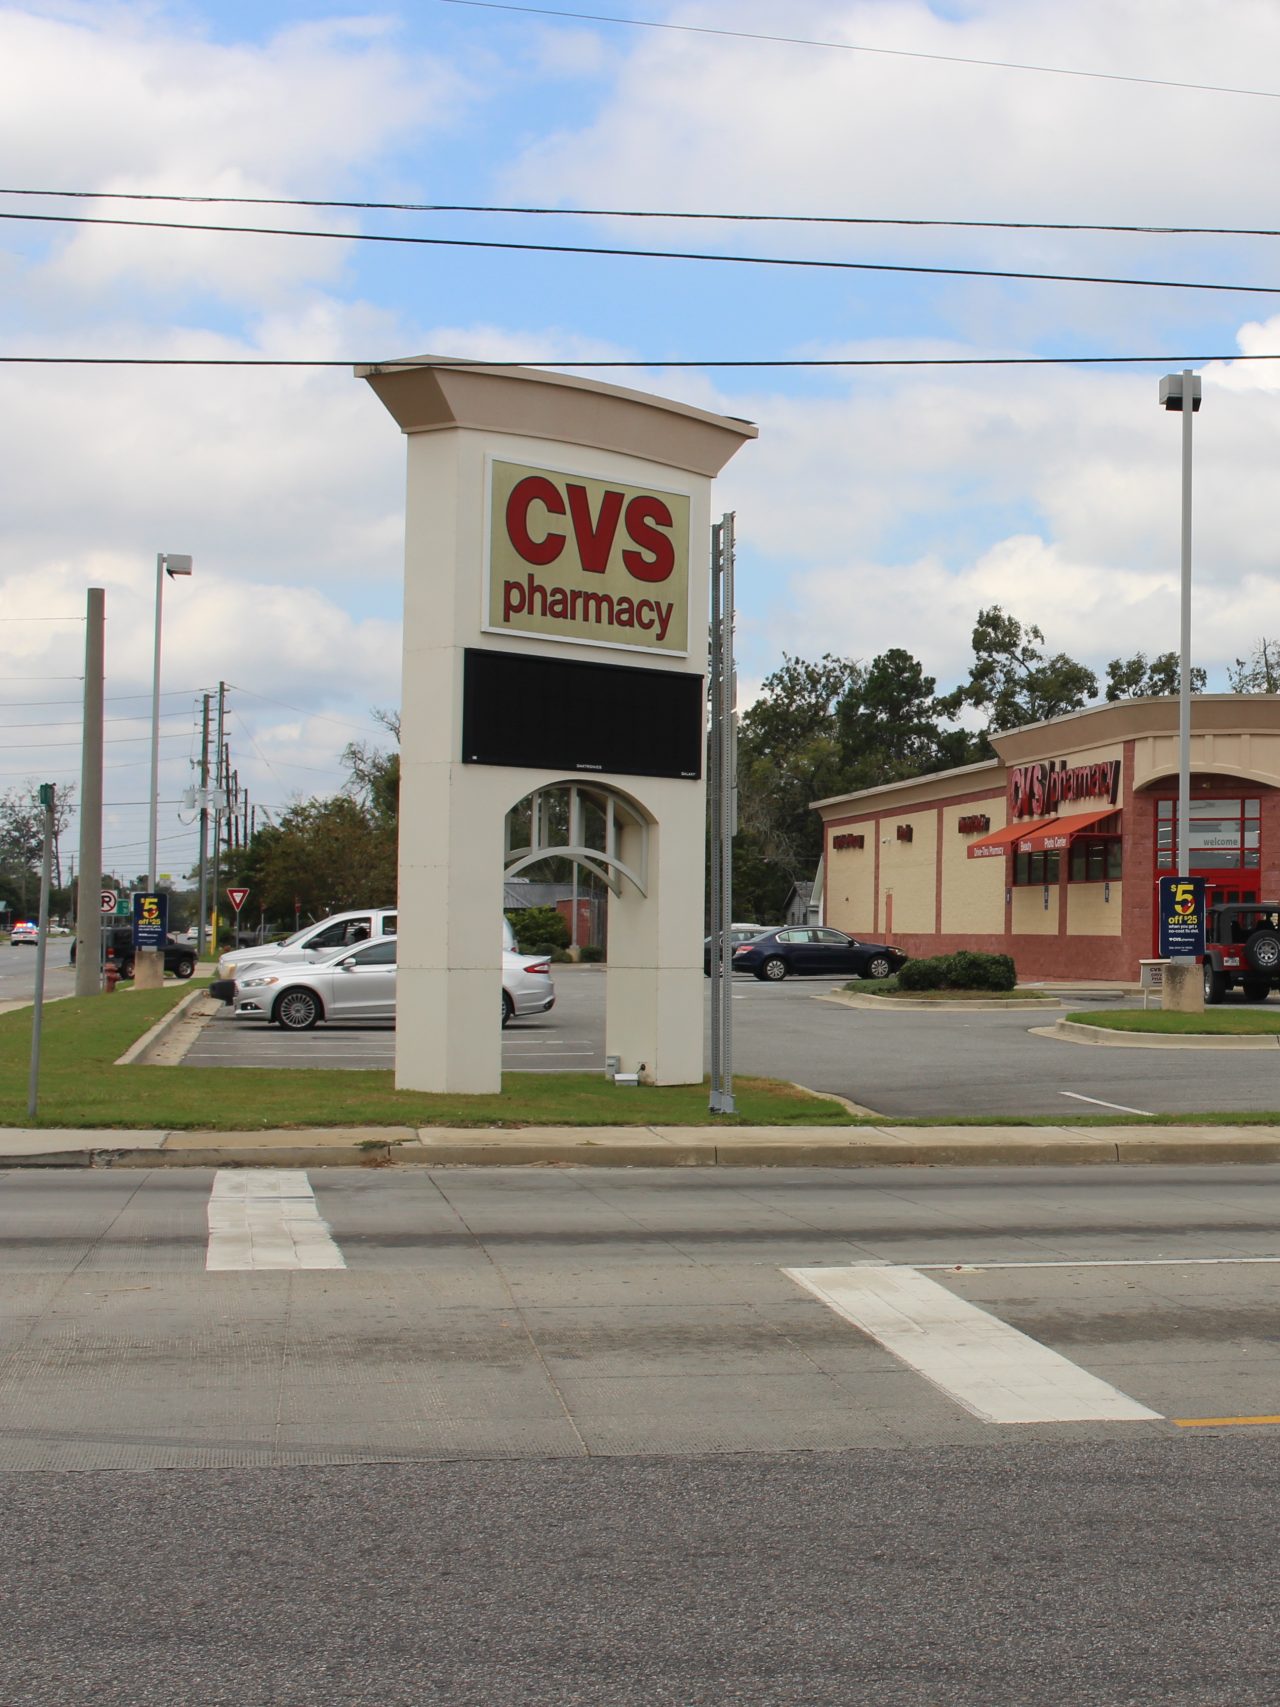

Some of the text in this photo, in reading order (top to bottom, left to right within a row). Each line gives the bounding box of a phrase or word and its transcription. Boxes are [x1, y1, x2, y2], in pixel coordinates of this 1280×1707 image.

[505, 475, 675, 583] CVS
[503, 573, 674, 641] pharmacy
[1203, 837, 1238, 846] welcome
[1168, 916, 1183, 924] off
